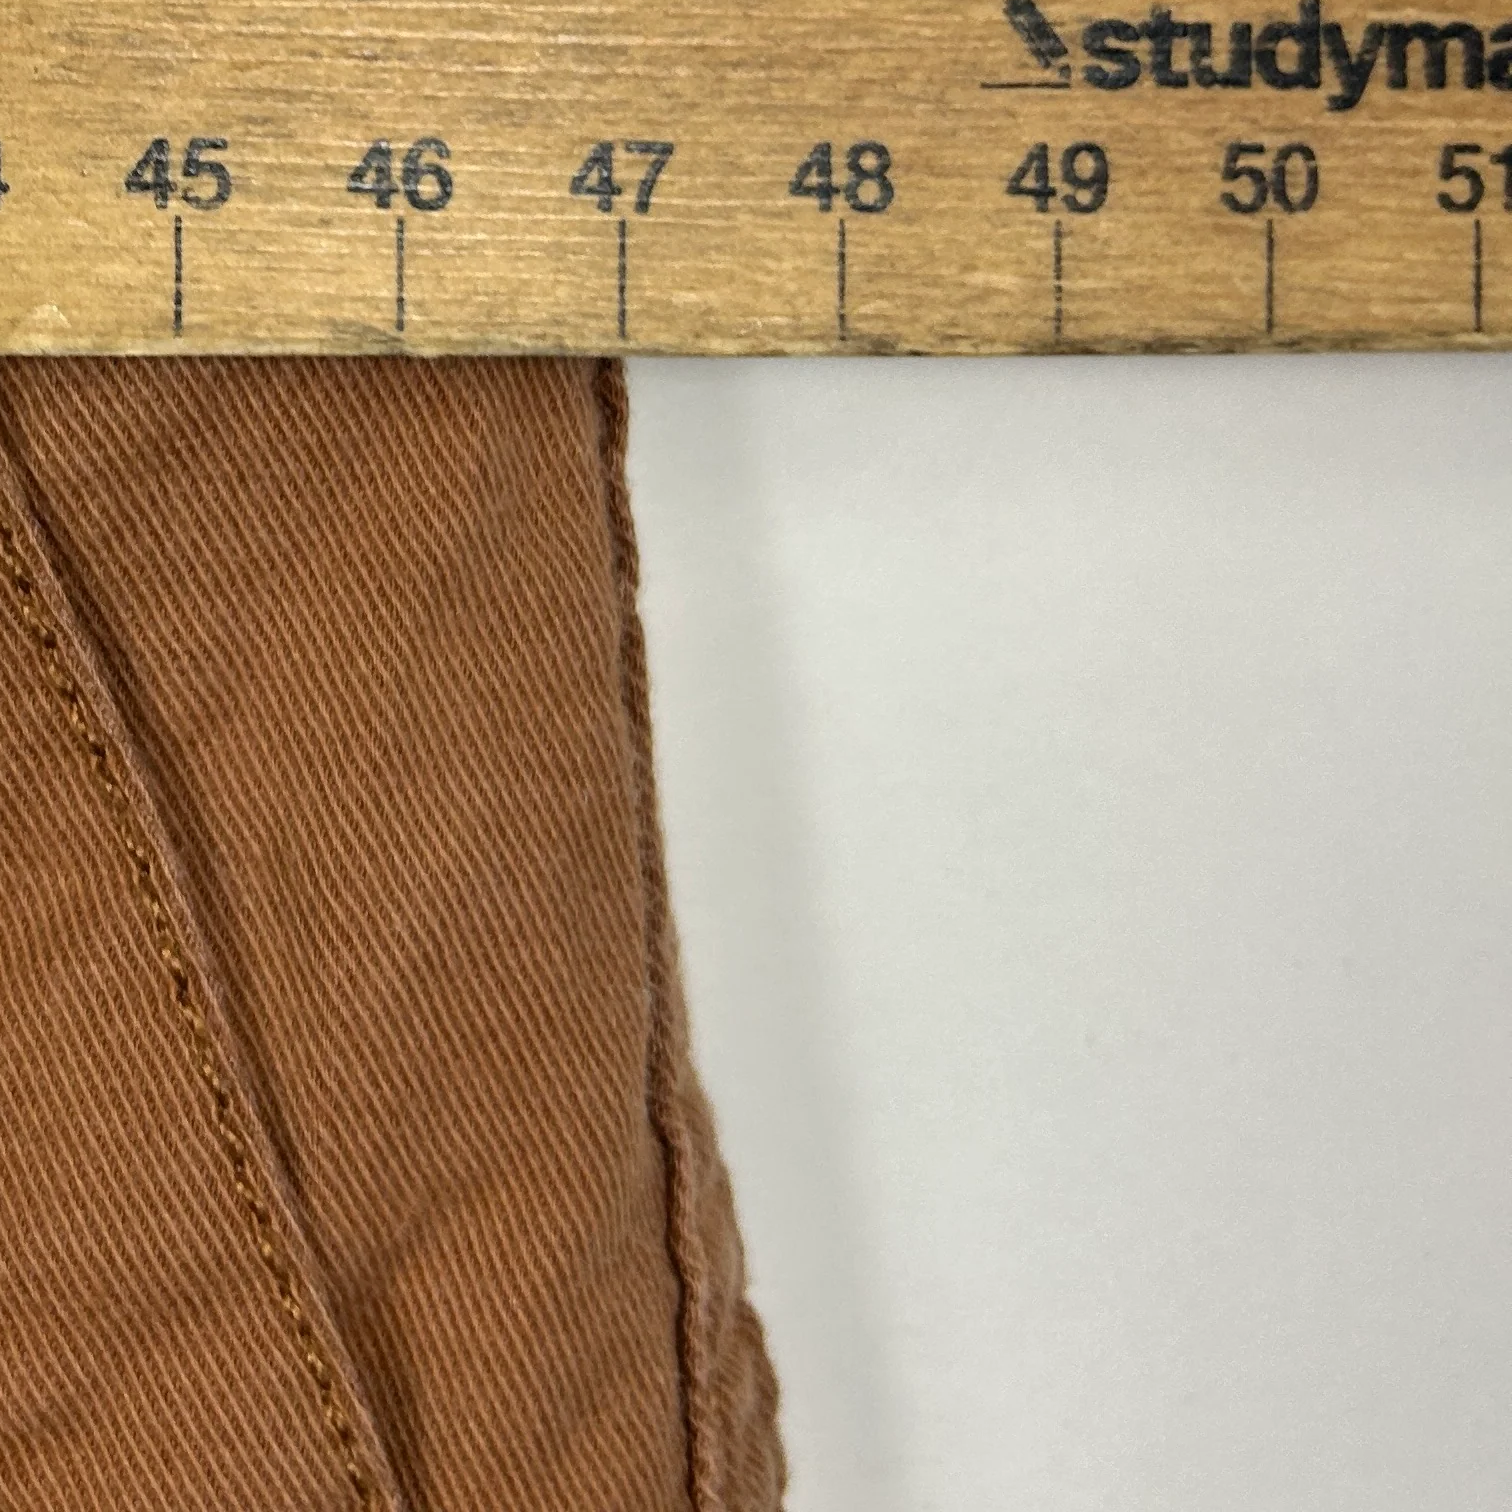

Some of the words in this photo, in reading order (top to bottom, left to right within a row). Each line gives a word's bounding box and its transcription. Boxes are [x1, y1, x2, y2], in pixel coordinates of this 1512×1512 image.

[124, 138, 232, 211] 45
[346, 139, 454, 211] 46
[570, 140, 674, 211] 47
[789, 141, 895, 212] 48
[1007, 141, 1109, 212] 49
[1221, 142, 1319, 212] 50
[1438, 143, 1512, 212] 51
